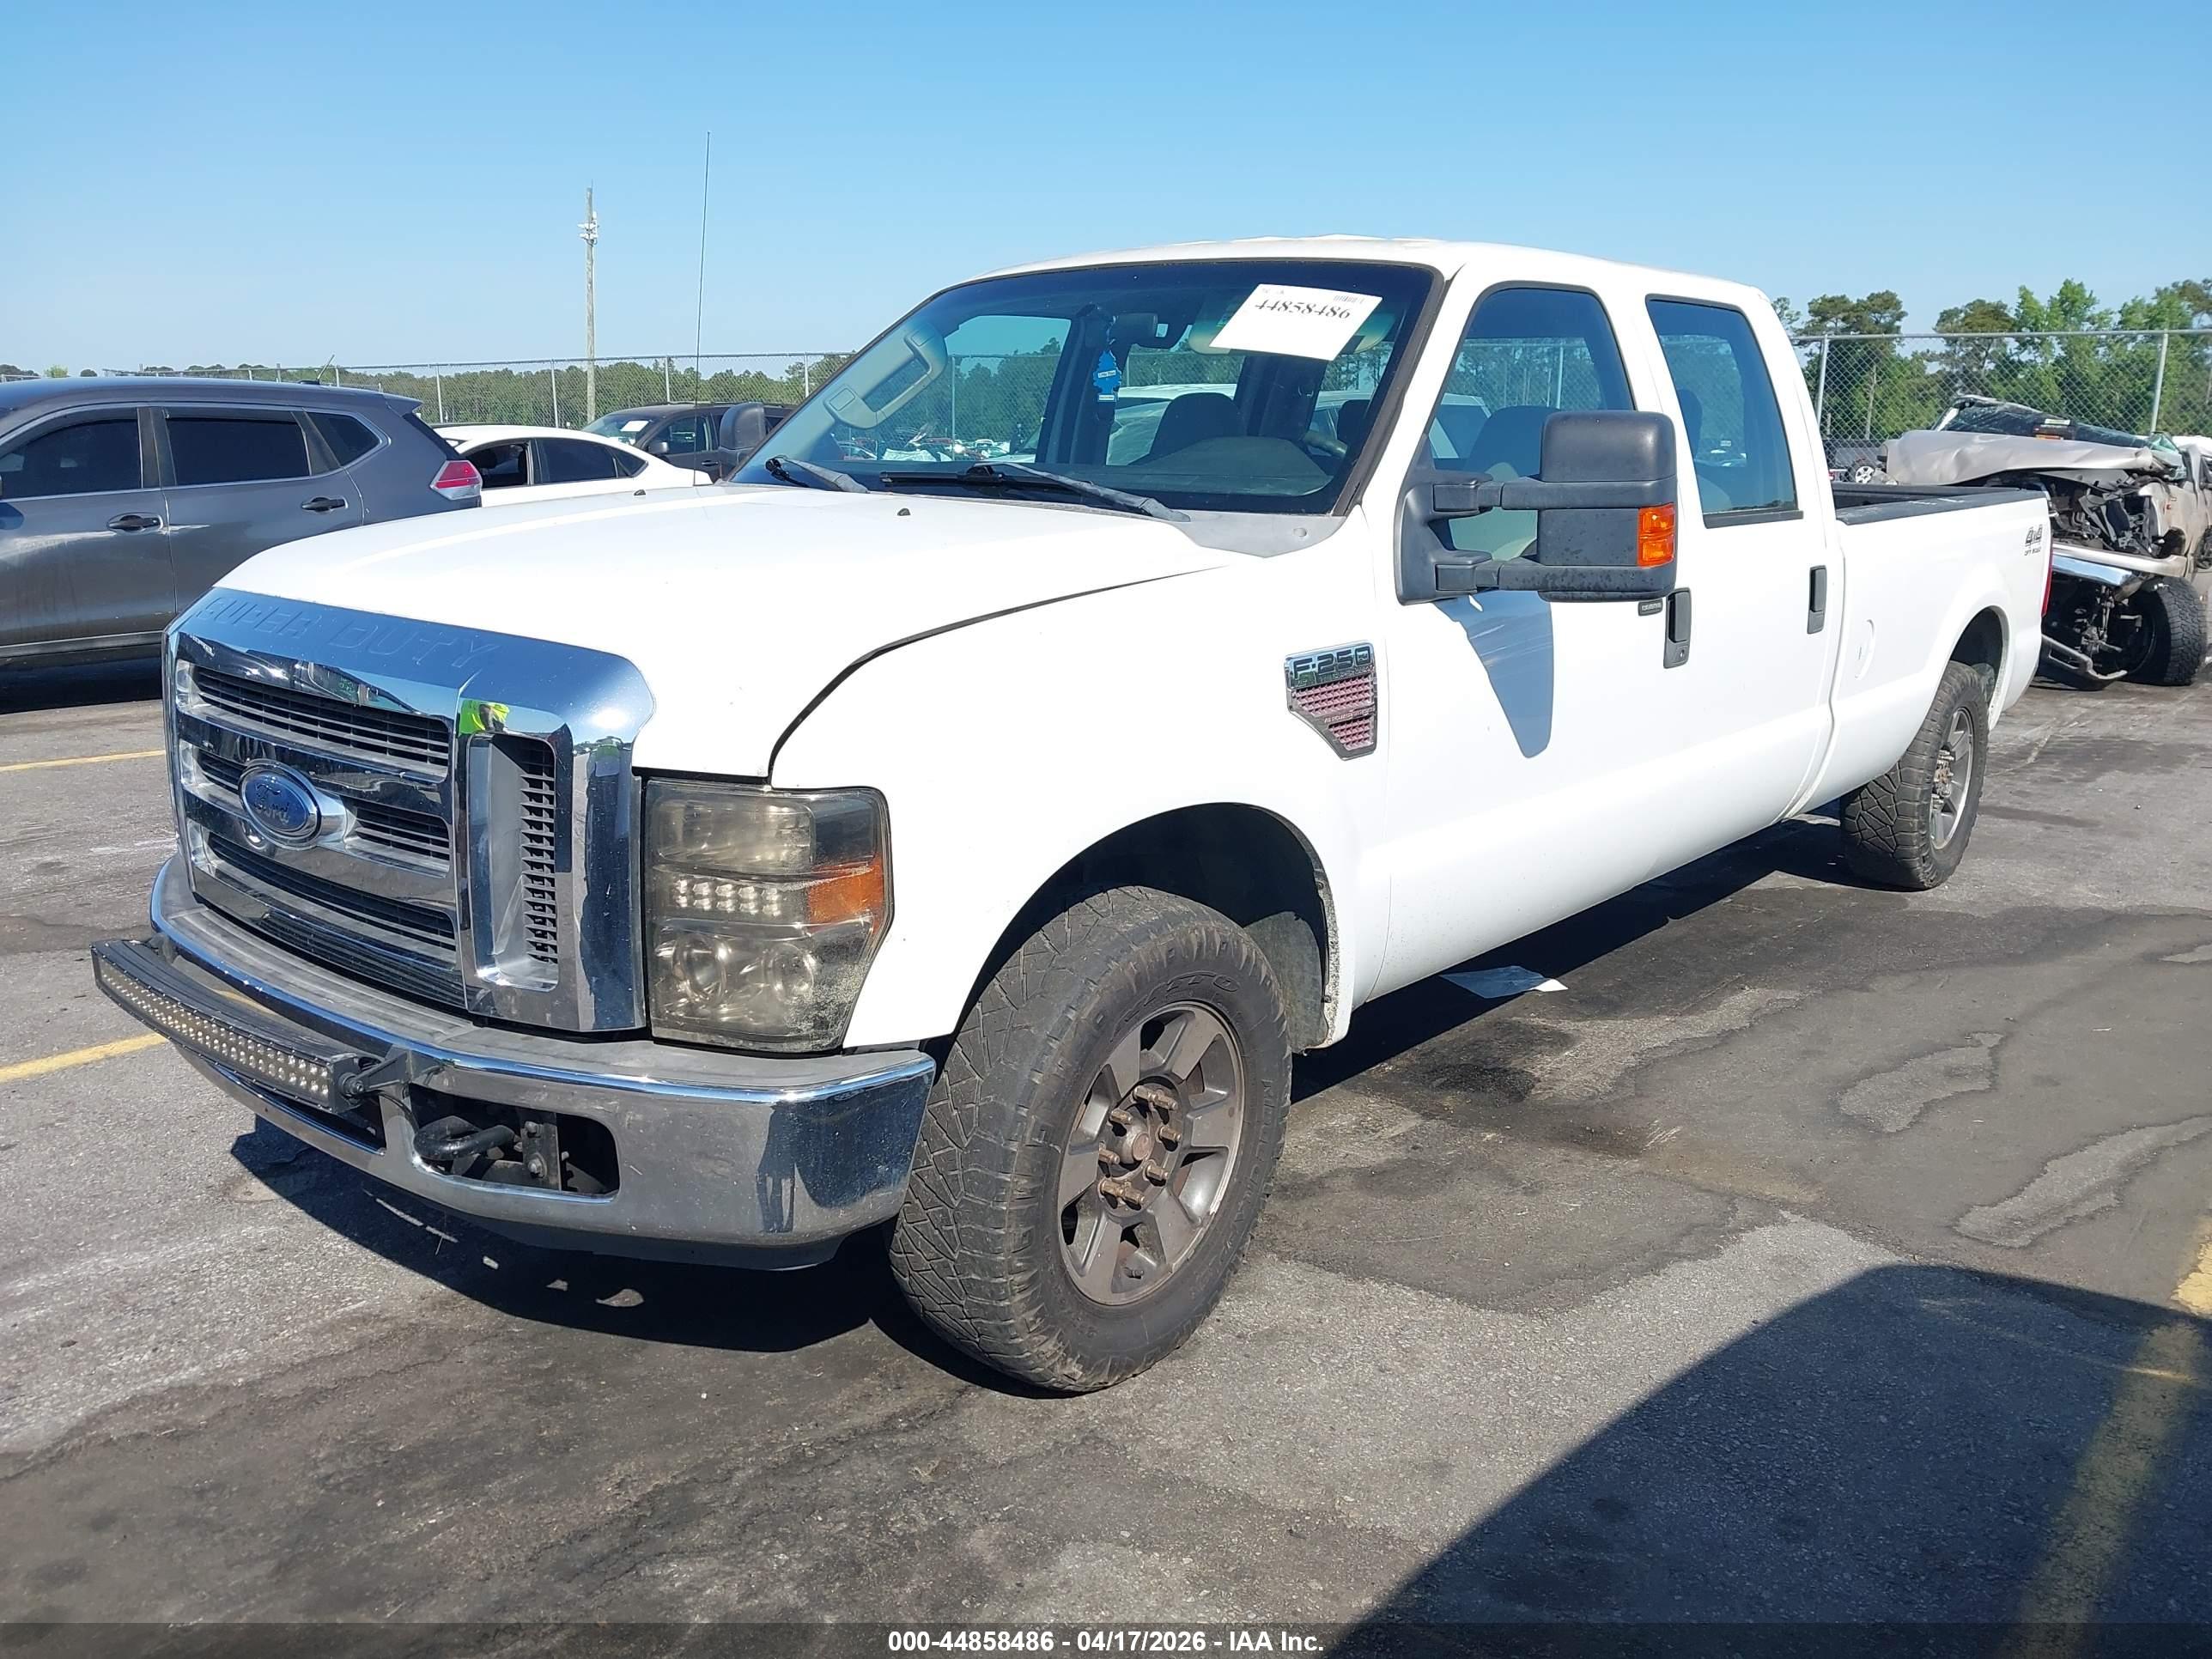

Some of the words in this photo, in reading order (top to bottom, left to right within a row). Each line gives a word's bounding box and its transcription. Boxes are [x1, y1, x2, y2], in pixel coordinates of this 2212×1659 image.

[1255, 299, 1351, 319] 44858486
[194, 597, 322, 639] SUPER
[328, 618, 501, 668] DUTY
[1293, 646, 1371, 680] F-250
